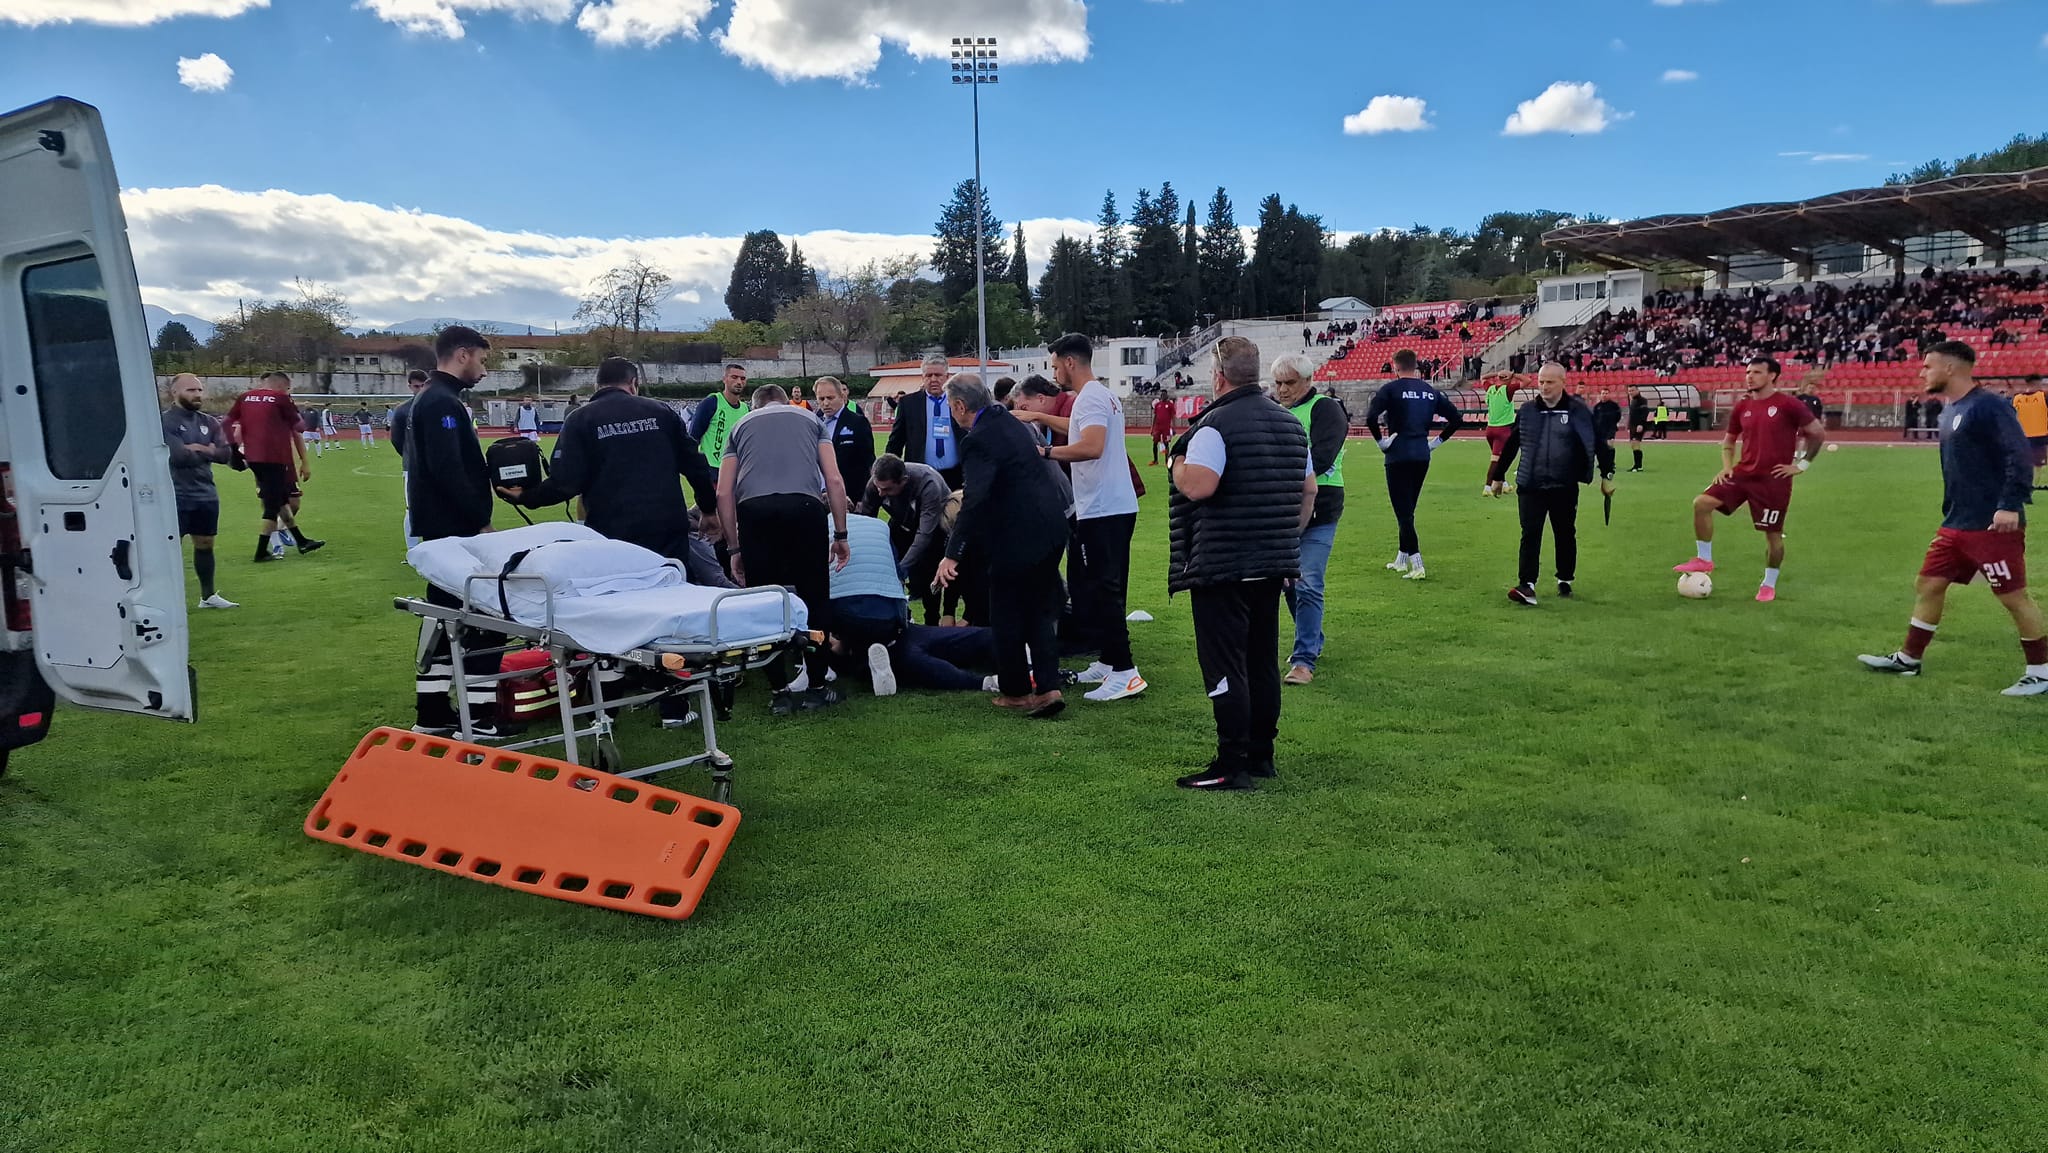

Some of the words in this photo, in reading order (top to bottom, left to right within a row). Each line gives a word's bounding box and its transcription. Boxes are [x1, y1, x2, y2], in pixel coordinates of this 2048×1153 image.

[262, 395, 276, 403] FC
[1402, 391, 1420, 399] AEL
[1422, 391, 1434, 400] FC
[1760, 508, 1780, 524] 10
[1983, 560, 2012, 582] 24
